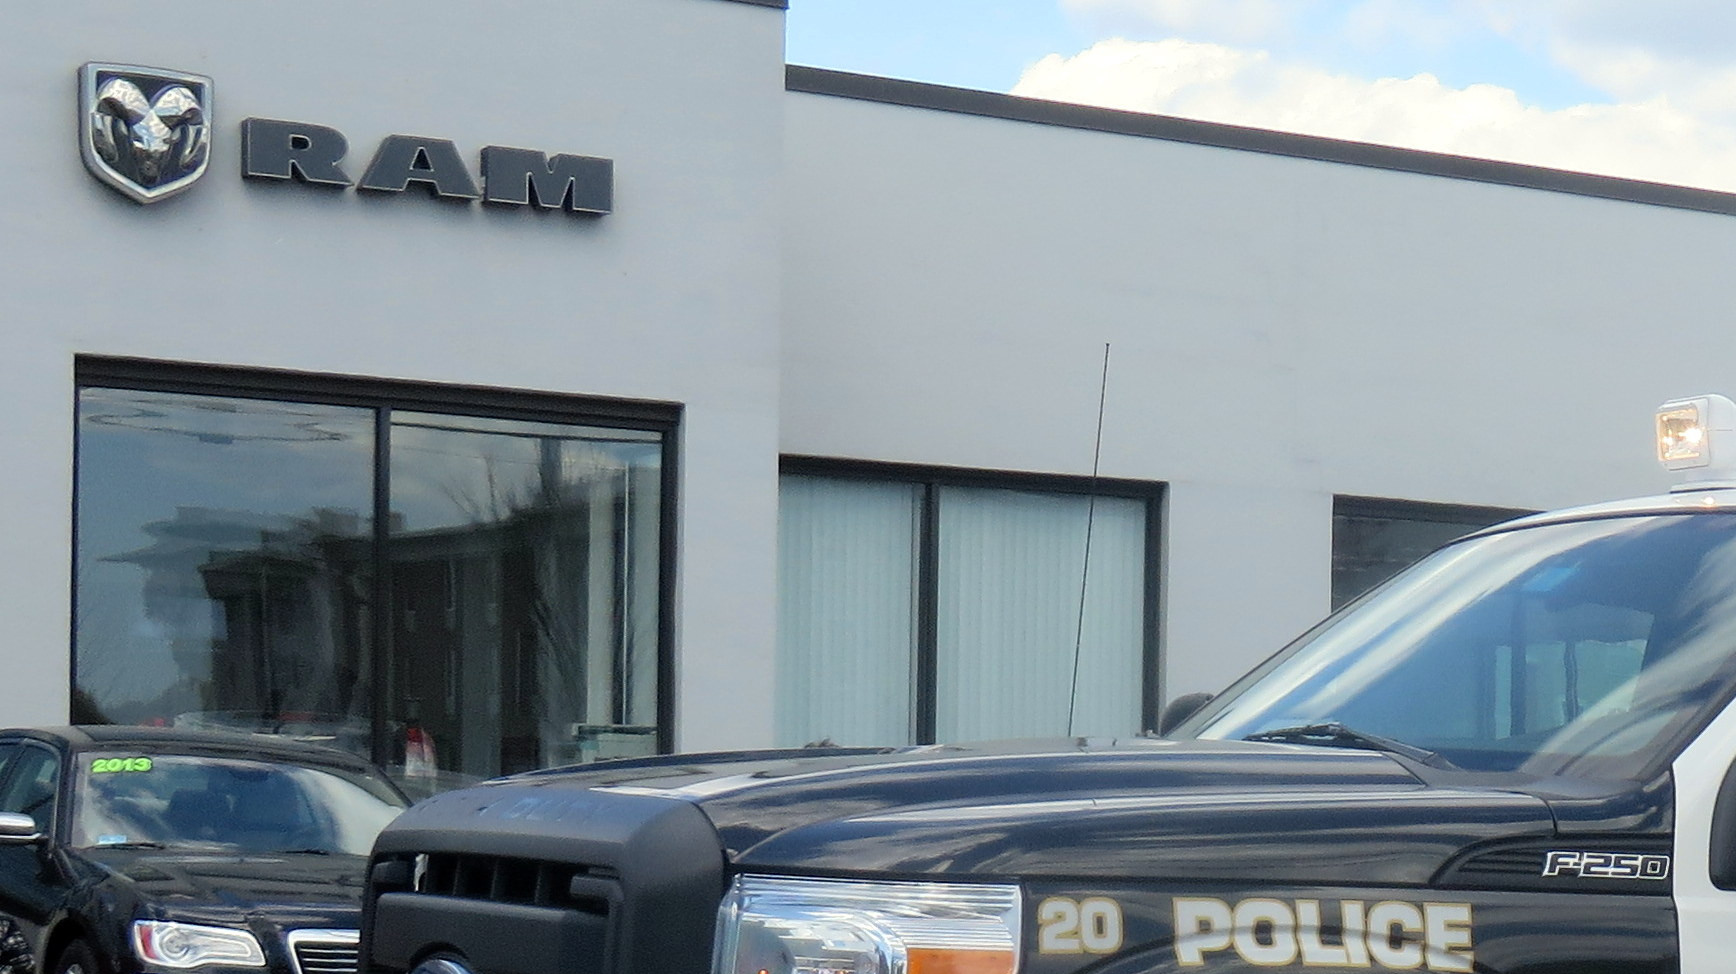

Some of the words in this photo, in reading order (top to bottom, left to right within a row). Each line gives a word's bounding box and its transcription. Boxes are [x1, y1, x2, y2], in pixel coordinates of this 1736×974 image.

[241, 116, 614, 214] RAM
[92, 758, 152, 773] 2013
[1542, 851, 1670, 880] F-250
[1036, 896, 1123, 956] 20
[1171, 896, 1476, 974] POLICE
